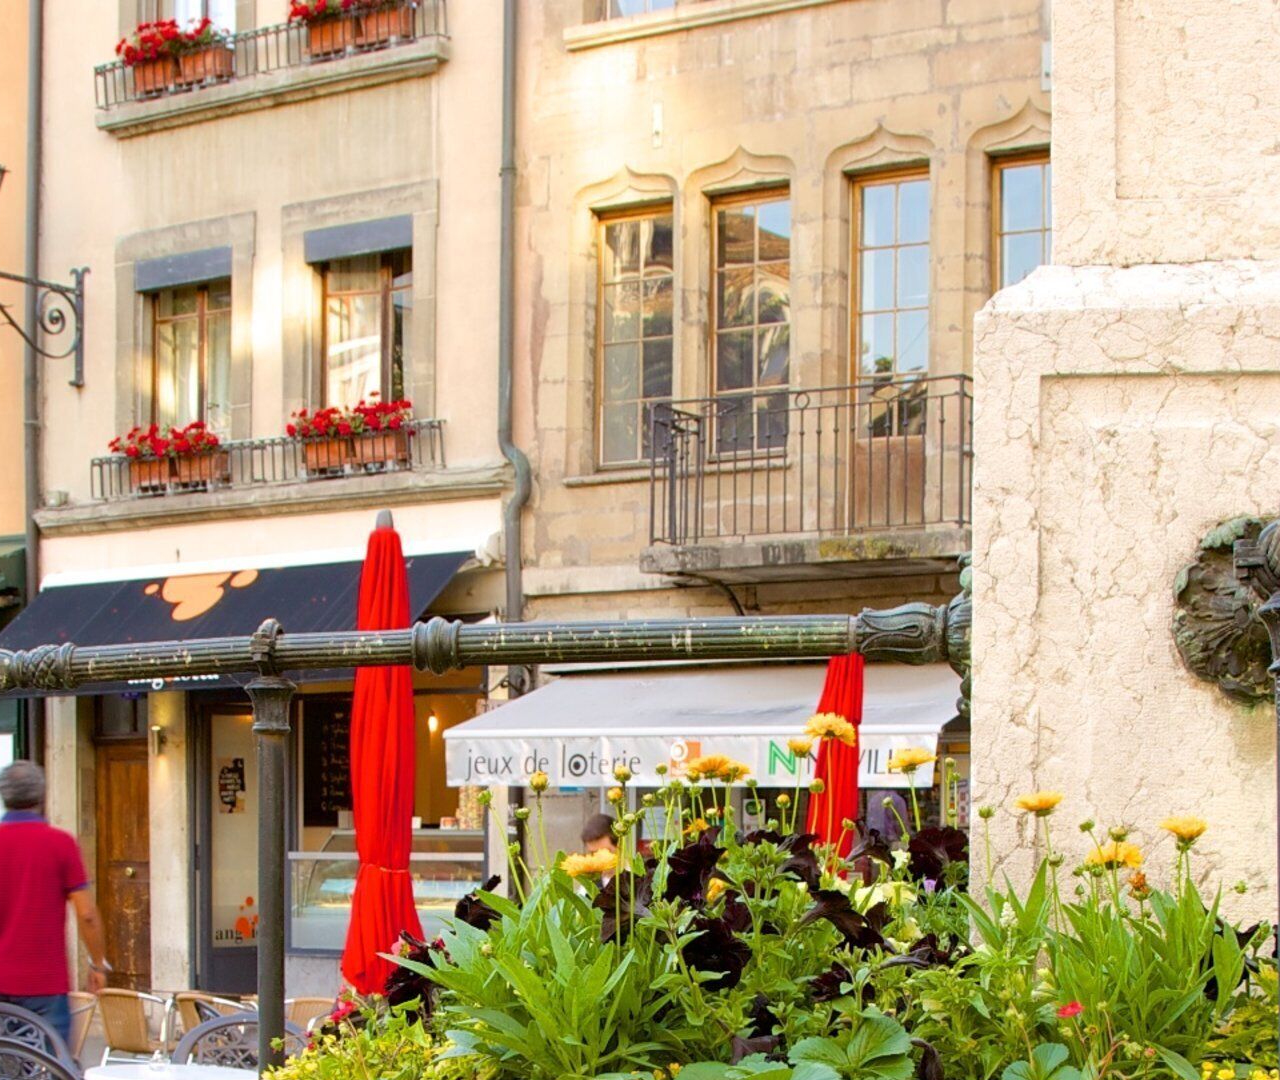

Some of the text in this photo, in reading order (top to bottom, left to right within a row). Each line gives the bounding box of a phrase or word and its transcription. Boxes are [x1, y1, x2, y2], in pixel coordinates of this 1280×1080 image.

[464, 748, 513, 782] jeux
[523, 748, 550, 775] de
[561, 743, 642, 778] loterie
